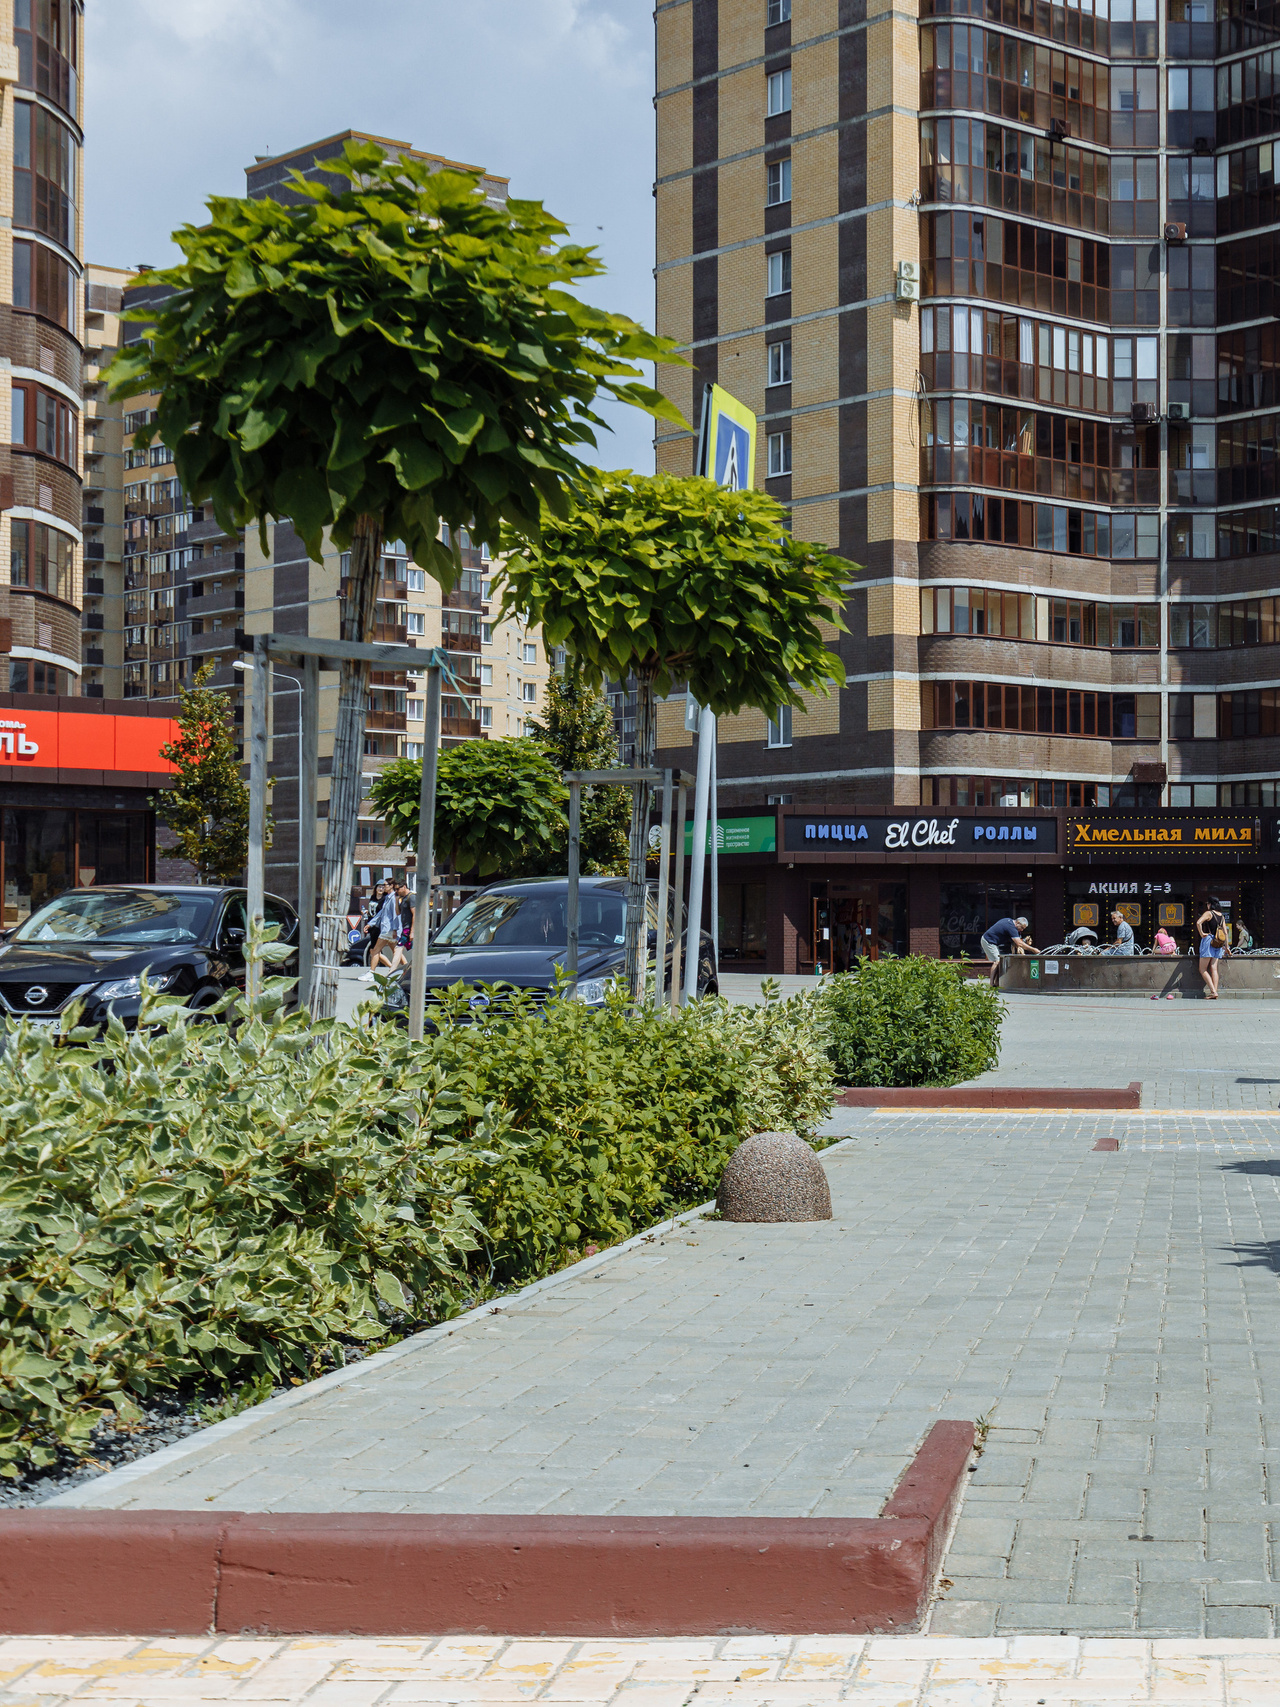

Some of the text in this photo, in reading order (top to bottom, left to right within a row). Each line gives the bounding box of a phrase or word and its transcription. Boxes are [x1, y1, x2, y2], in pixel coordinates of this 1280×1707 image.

[805, 818, 1037, 848] ПИЦЦА El Chef РОЛЛЫ
[1074, 824, 1252, 841] Хмельная миля
[1088, 882, 1172, 894] АКЦИЯ 2=3
[947, 914, 980, 934] Chef
